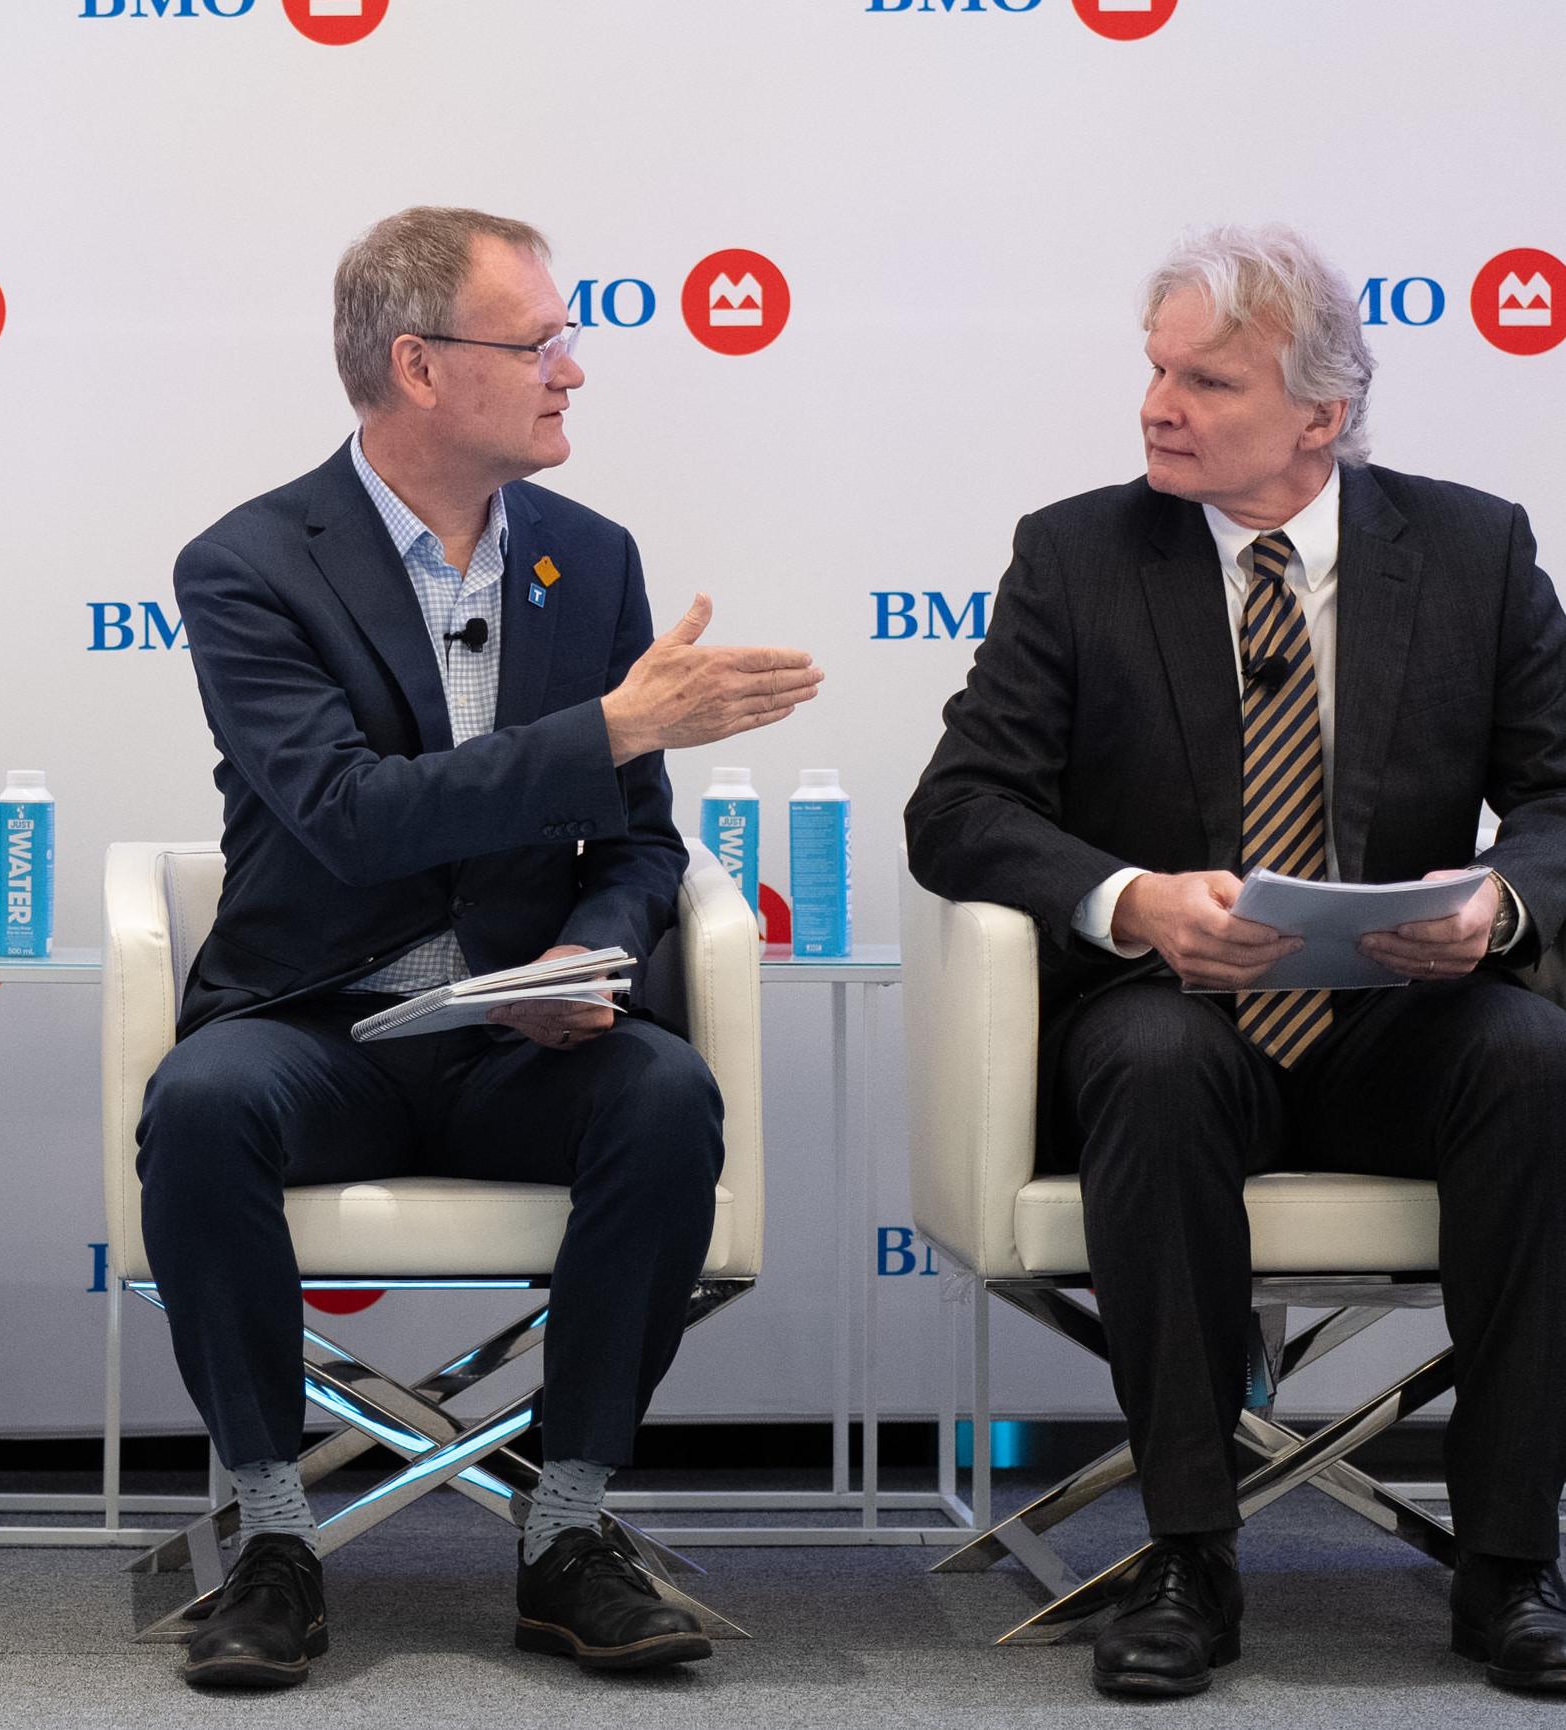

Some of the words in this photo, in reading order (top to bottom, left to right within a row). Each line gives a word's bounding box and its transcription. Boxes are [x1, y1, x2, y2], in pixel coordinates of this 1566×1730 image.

[86, 600, 191, 652] BM
[870, 591, 991, 641] BM
[9, 820, 32, 829] JUST
[720, 817, 743, 827] JUST
[8, 831, 32, 923] WATER
